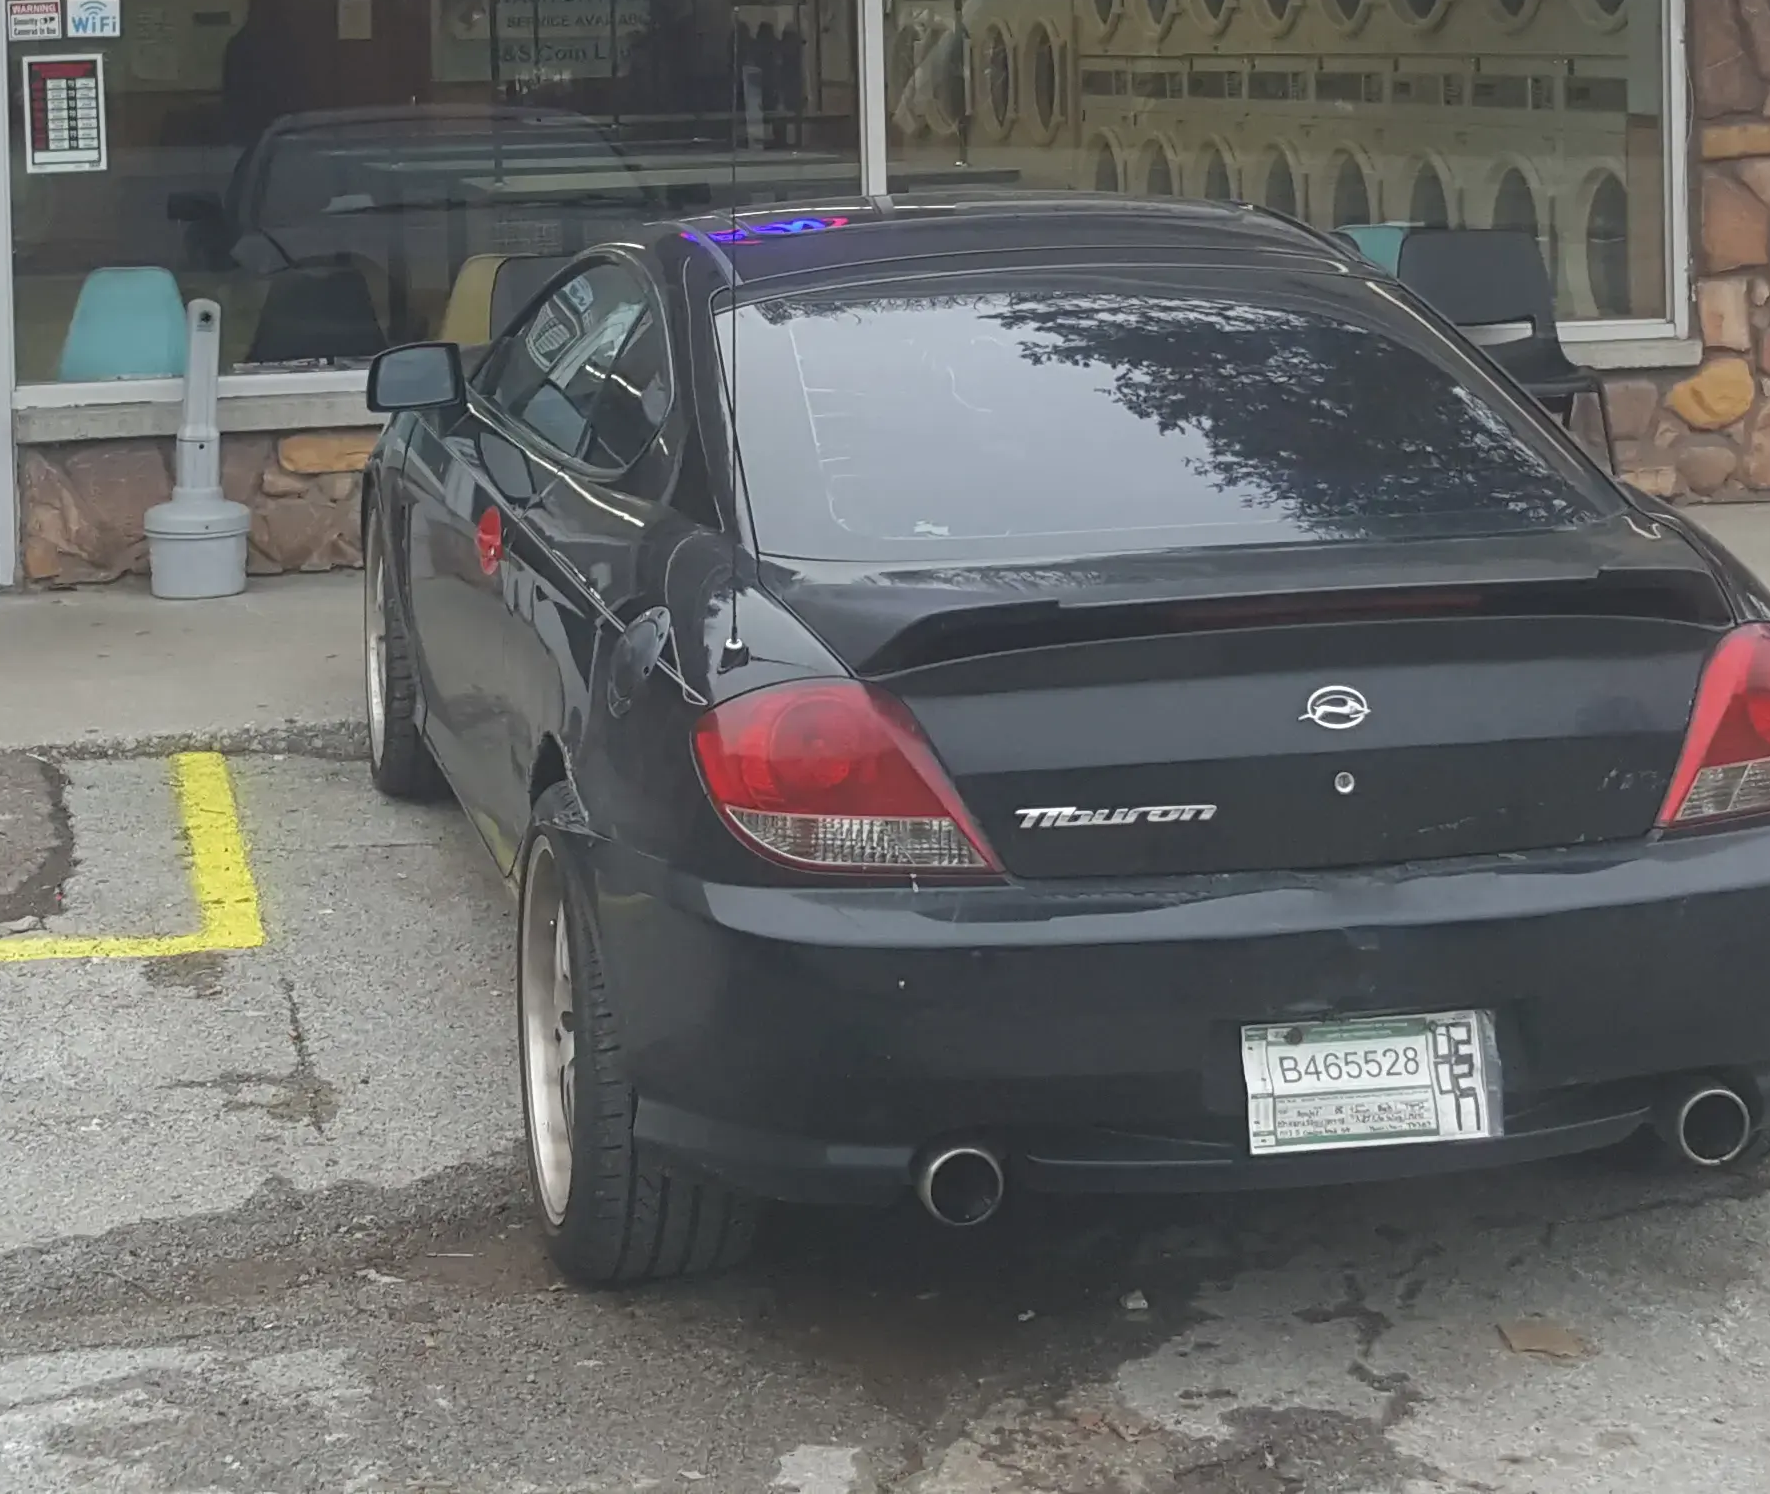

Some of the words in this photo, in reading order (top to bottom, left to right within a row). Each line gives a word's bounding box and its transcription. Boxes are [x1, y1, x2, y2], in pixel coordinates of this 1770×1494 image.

[11, 3, 57, 14] WARNING
[72, 16, 117, 33] WiFi
[1014, 804, 1218, 828] Tiburon
[1278, 1046, 1421, 1084] B465528
